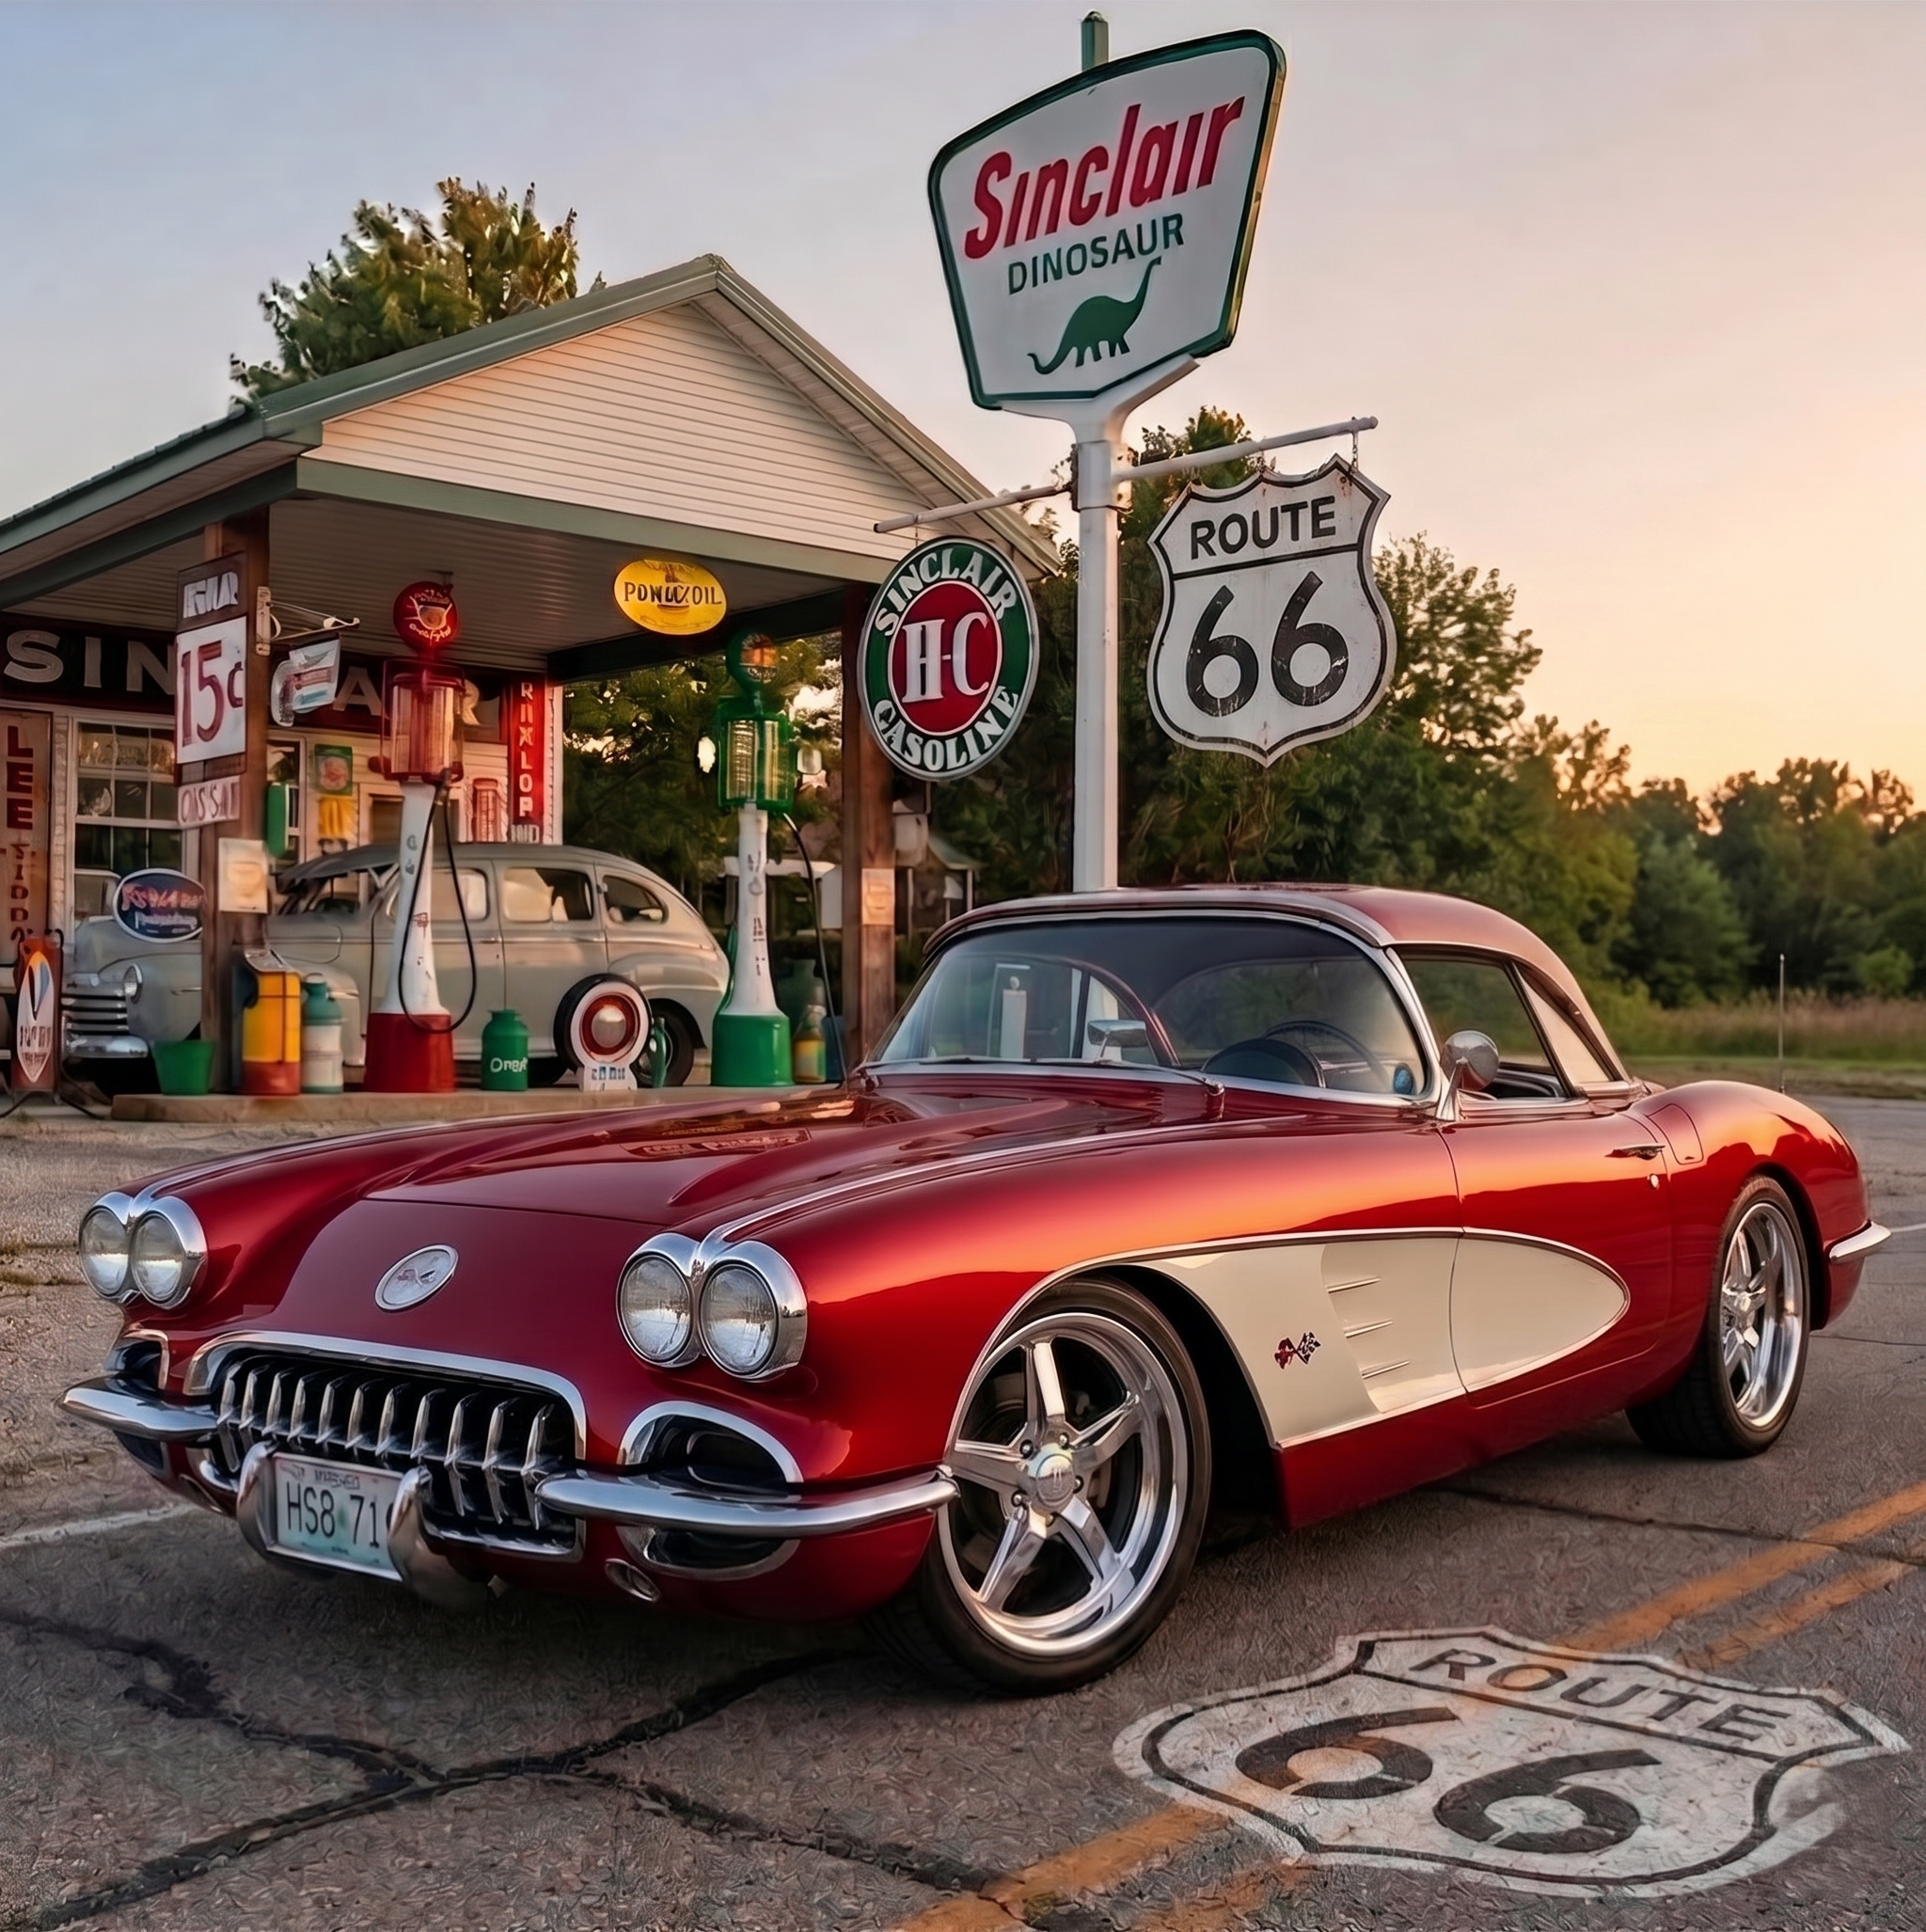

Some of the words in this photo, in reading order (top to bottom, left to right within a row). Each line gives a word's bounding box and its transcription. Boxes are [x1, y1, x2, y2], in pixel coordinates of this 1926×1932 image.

[963, 95, 1245, 259] Sinclair
[1008, 213, 1185, 295] DINOSAUR
[1191, 495, 1336, 561] ROUTE
[875, 547, 1018, 637] SINCLAIR
[1186, 570, 1350, 718] 66
[874, 685, 1018, 772] GASOLINE
[7, 725, 34, 831] LEE
[286, 1481, 336, 1539] HS8
[349, 1494, 396, 1549] 71
[1411, 1647, 1795, 1742] ROUTE
[1235, 1706, 1663, 1853] 66
